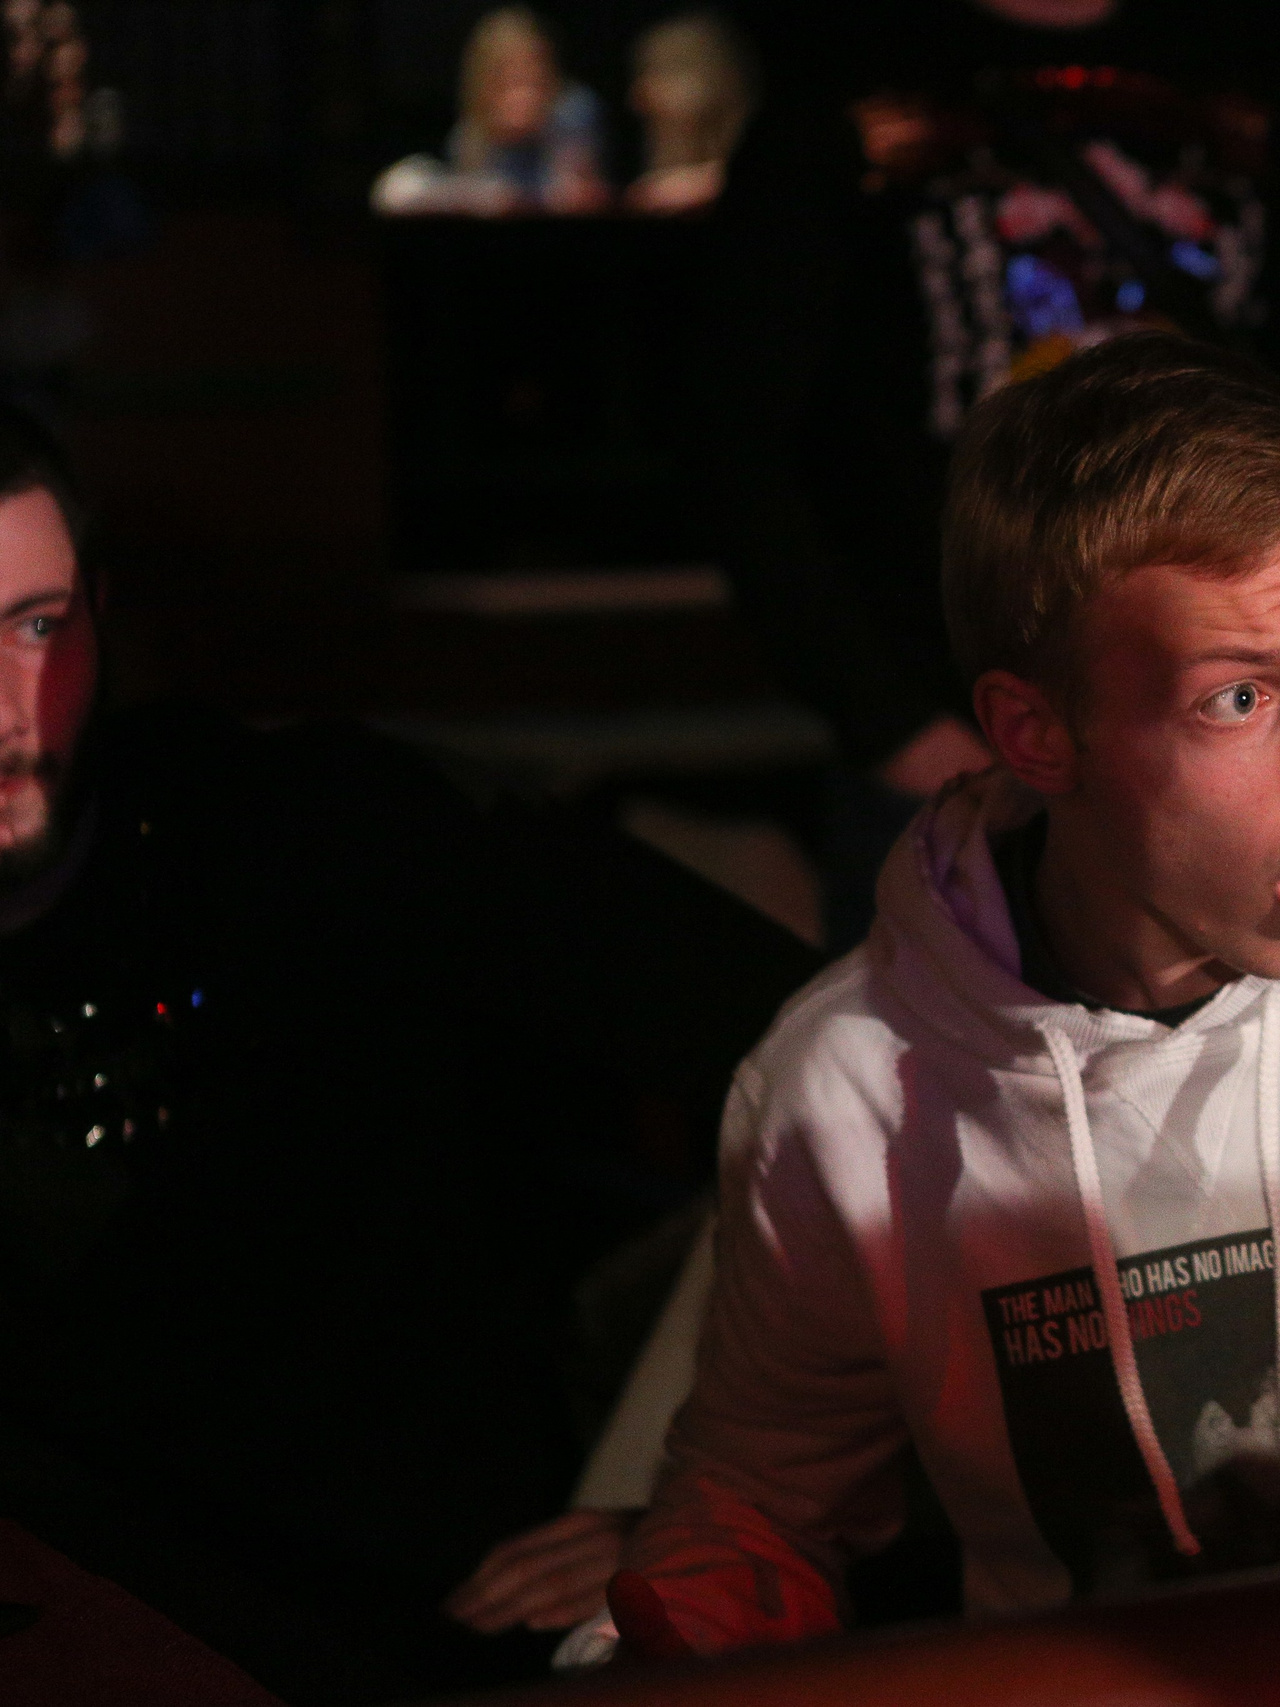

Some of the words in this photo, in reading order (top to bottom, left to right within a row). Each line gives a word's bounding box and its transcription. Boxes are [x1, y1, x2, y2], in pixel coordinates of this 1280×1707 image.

[998, 1291, 1040, 1324] THE
[1043, 1280, 1094, 1316] MAN
[1120, 1267, 1144, 1299] HO
[1145, 1256, 1191, 1293] HAS
[1191, 1250, 1223, 1282] NO
[1003, 1321, 1063, 1365] HAS
[1066, 1310, 1109, 1355] NO
[1128, 1289, 1202, 1341] INGS
